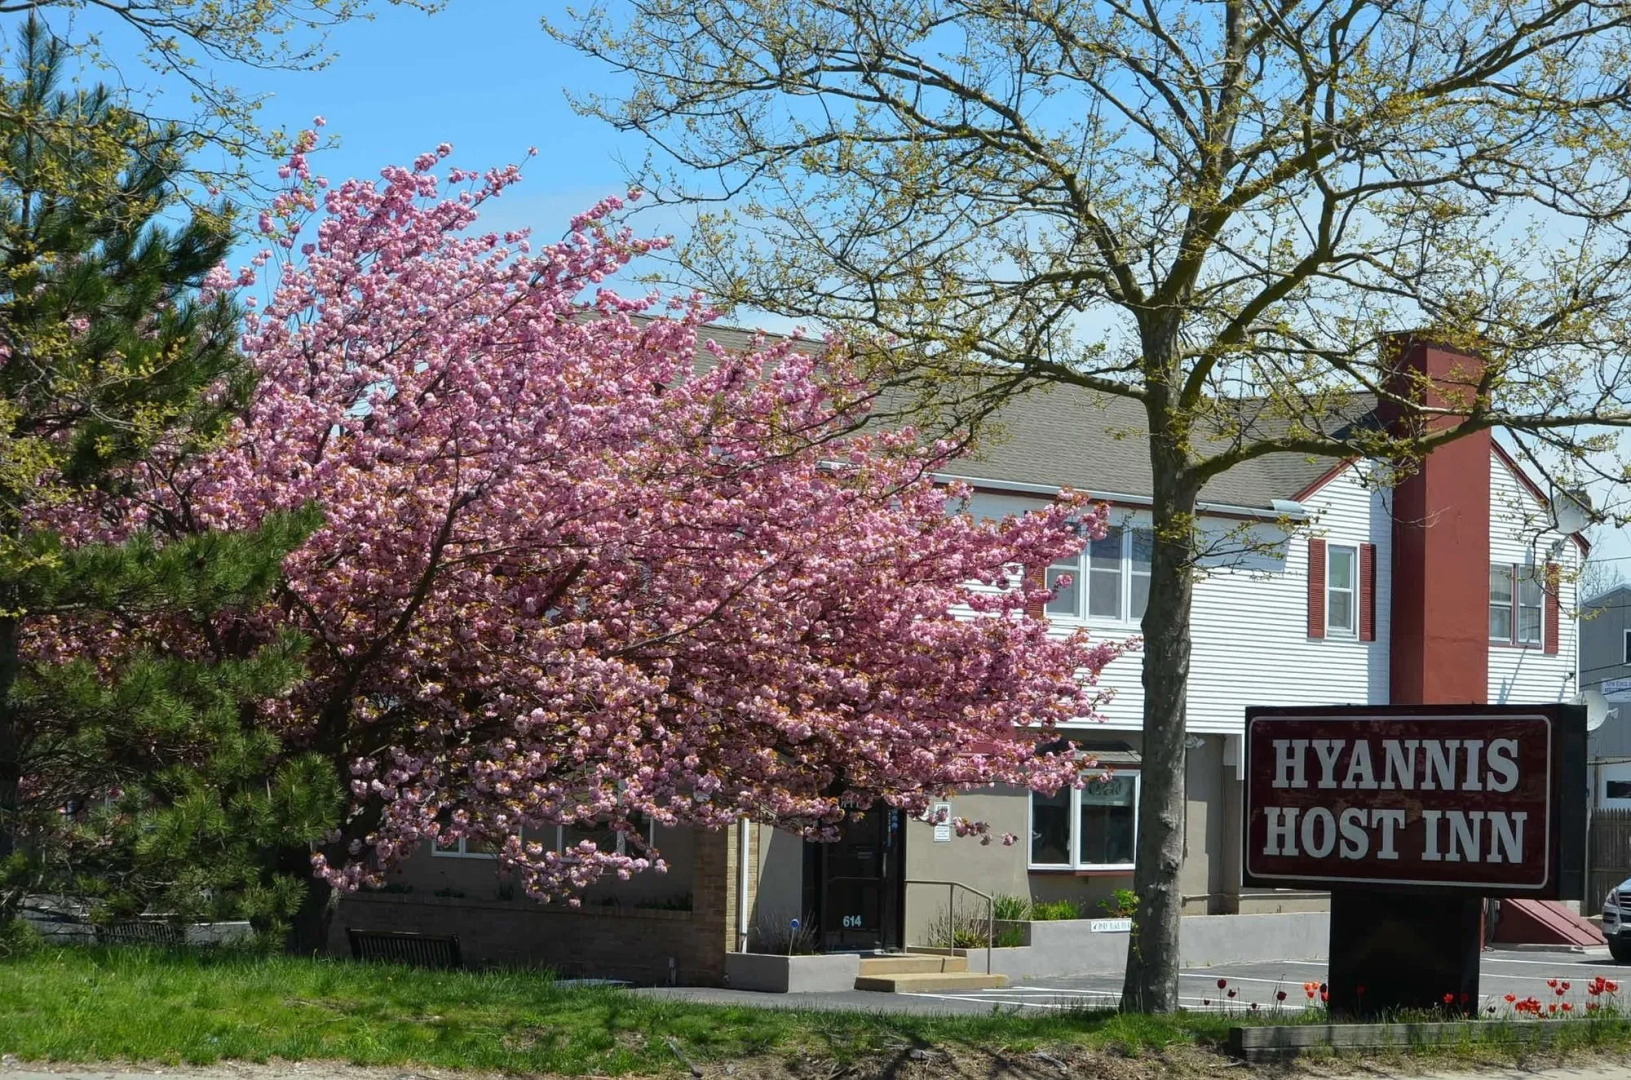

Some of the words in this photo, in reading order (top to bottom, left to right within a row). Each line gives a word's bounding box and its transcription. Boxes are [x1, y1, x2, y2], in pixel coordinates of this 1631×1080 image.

[1272, 738, 1520, 793] HYANNIS
[1263, 806, 1406, 860] HOST
[1421, 810, 1528, 864] INN
[843, 915, 862, 927] 614
